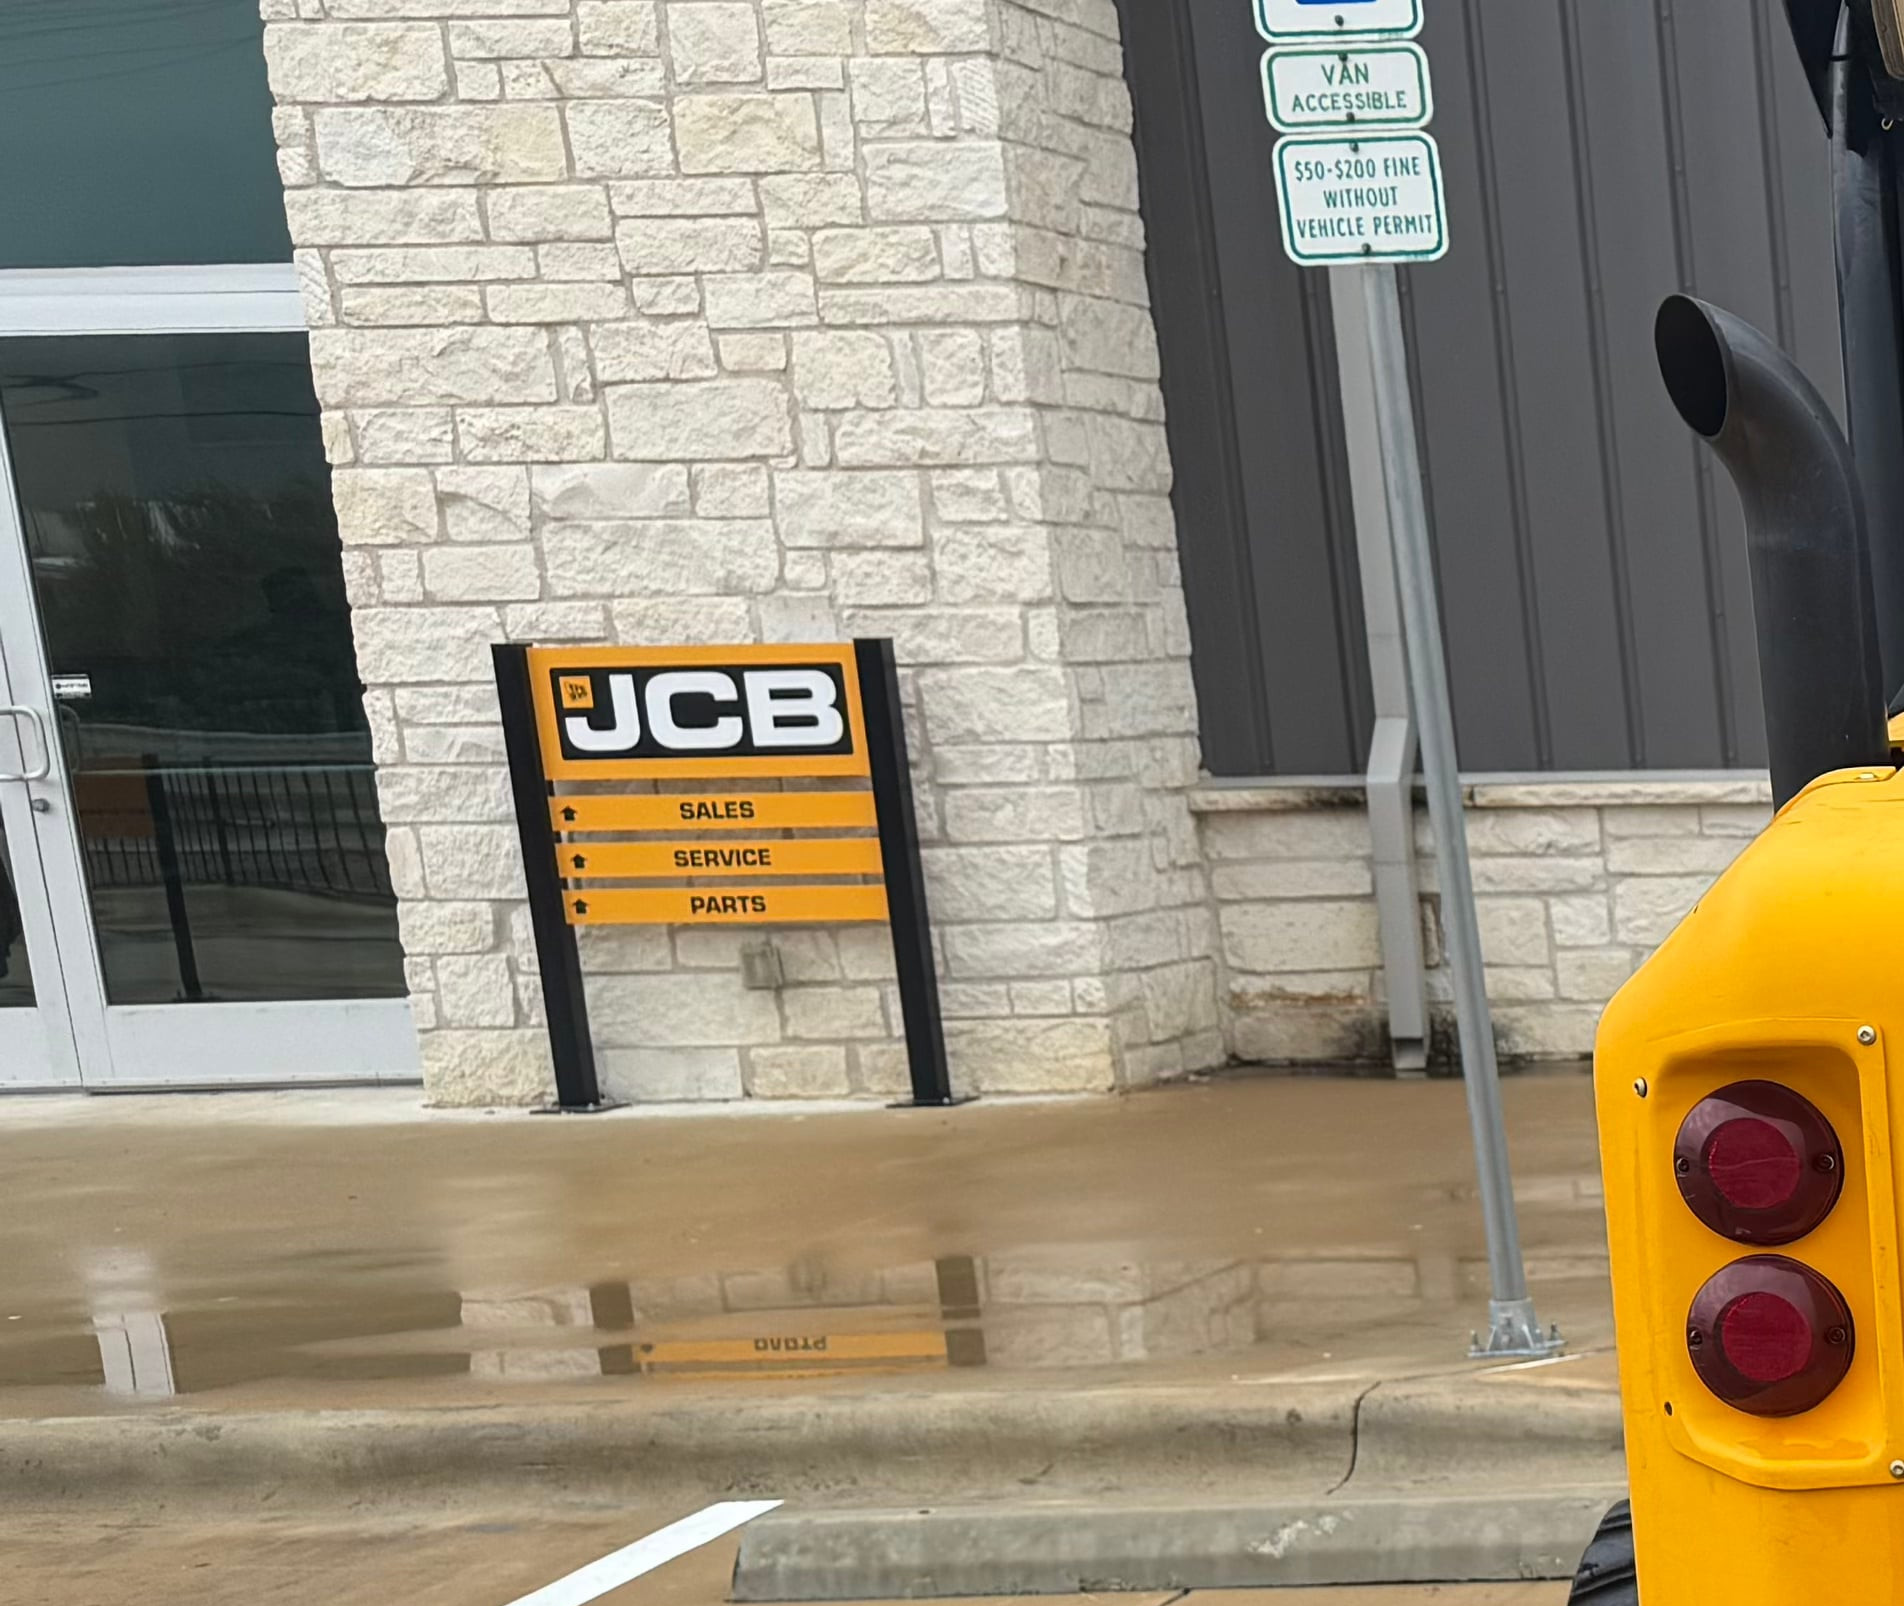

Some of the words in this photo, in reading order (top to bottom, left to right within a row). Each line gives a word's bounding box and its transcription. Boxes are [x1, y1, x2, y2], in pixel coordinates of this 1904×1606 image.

[1320, 63, 1370, 86] VAN
[1291, 90, 1407, 113] ACCESSIBLE
[1294, 158, 1376, 182] $50-$200
[1383, 156, 1421, 178] FINE
[1323, 185, 1398, 209] WITHOUT
[1296, 217, 1365, 239] VEHICLE
[1373, 214, 1433, 236] PERMIT
[564, 669, 844, 752] JCB
[679, 801, 755, 820] SALES
[673, 848, 772, 868] SERVICE
[690, 895, 767, 915] PARTS
